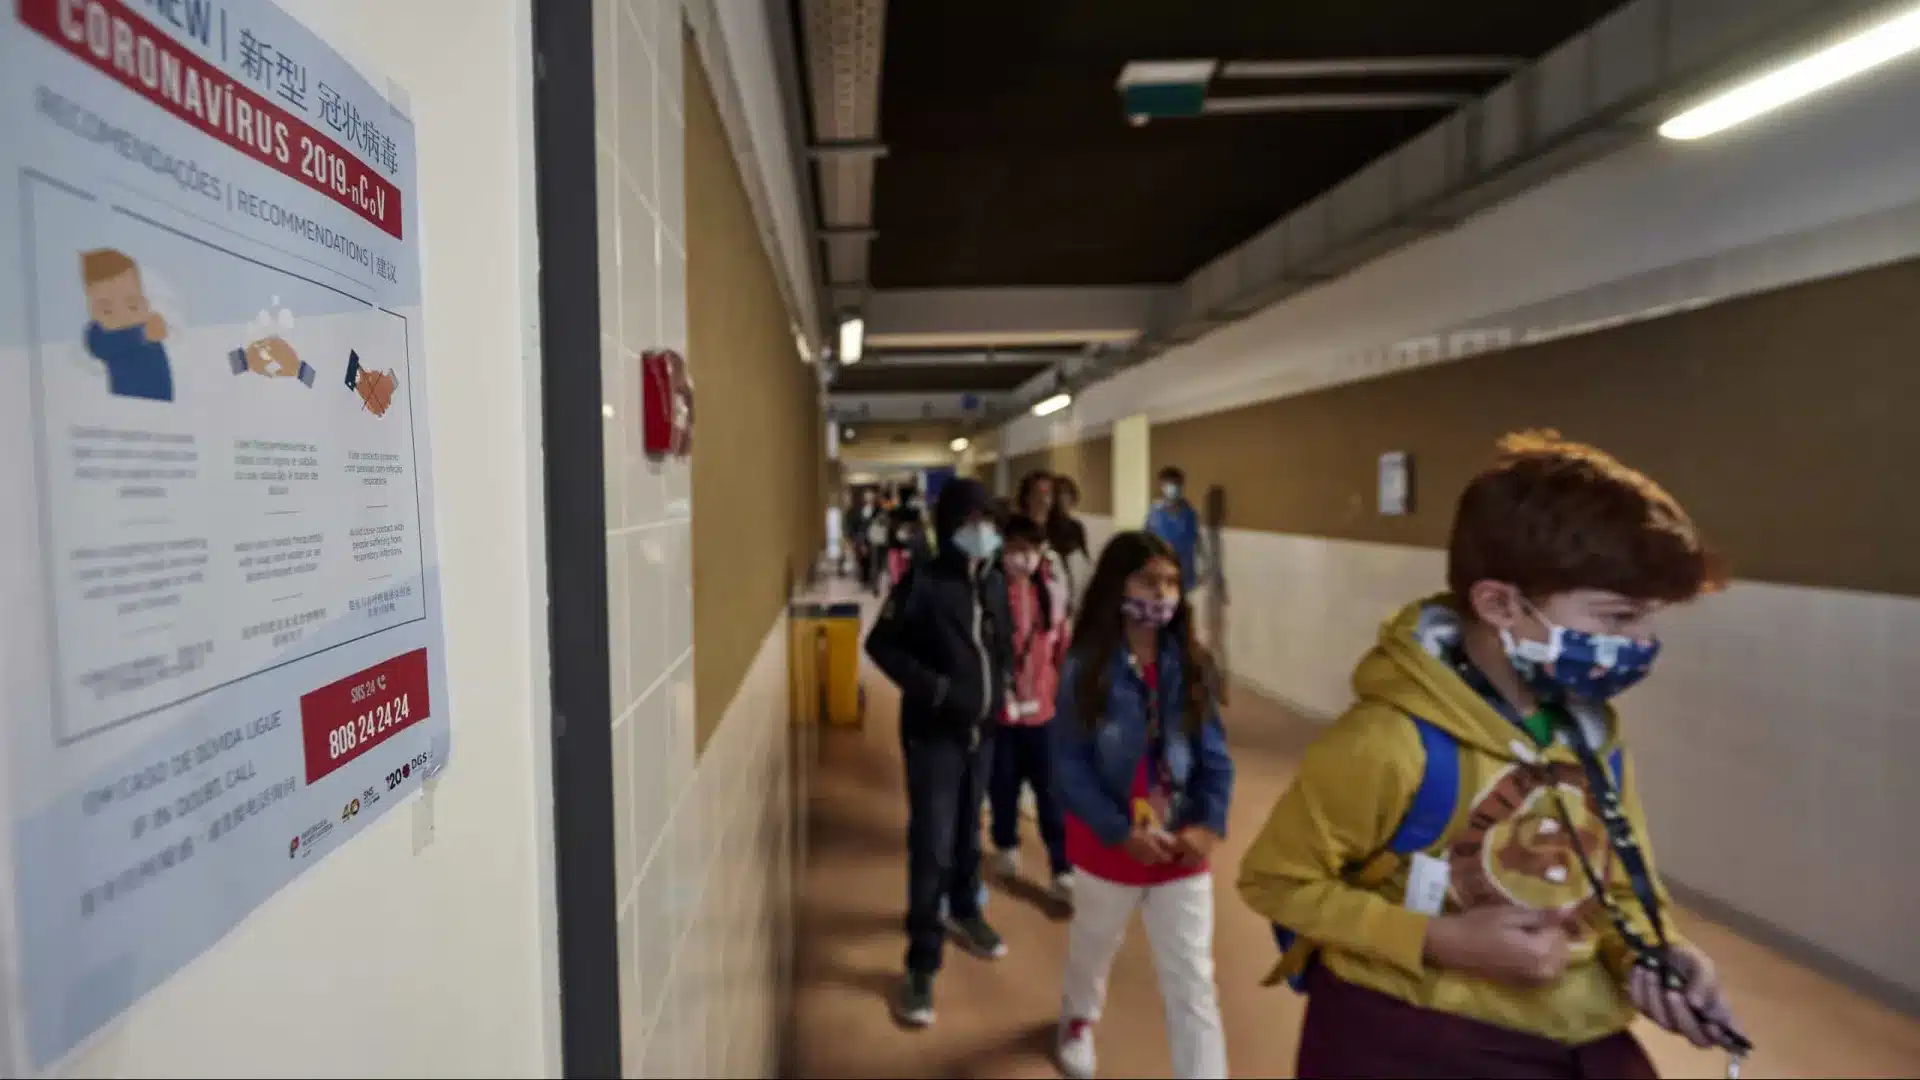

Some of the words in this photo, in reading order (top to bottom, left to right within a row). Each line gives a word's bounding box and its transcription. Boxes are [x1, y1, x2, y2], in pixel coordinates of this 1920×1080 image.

[144, 0, 211, 46] EW
[57, 0, 290, 164] CORONAVÍRUS
[300, 136, 385, 221] 2019-nCoV
[239, 28, 308, 112] 新型
[317, 80, 398, 175] 冠状病毒
[237, 189, 369, 267] RECOMMENDATIONS
[366, 680, 376, 697] 24
[329, 720, 356, 759] 808
[358, 710, 375, 743] 24
[376, 701, 392, 733] 24
[394, 693, 410, 724] 24
[411, 751, 428, 770] DGS
